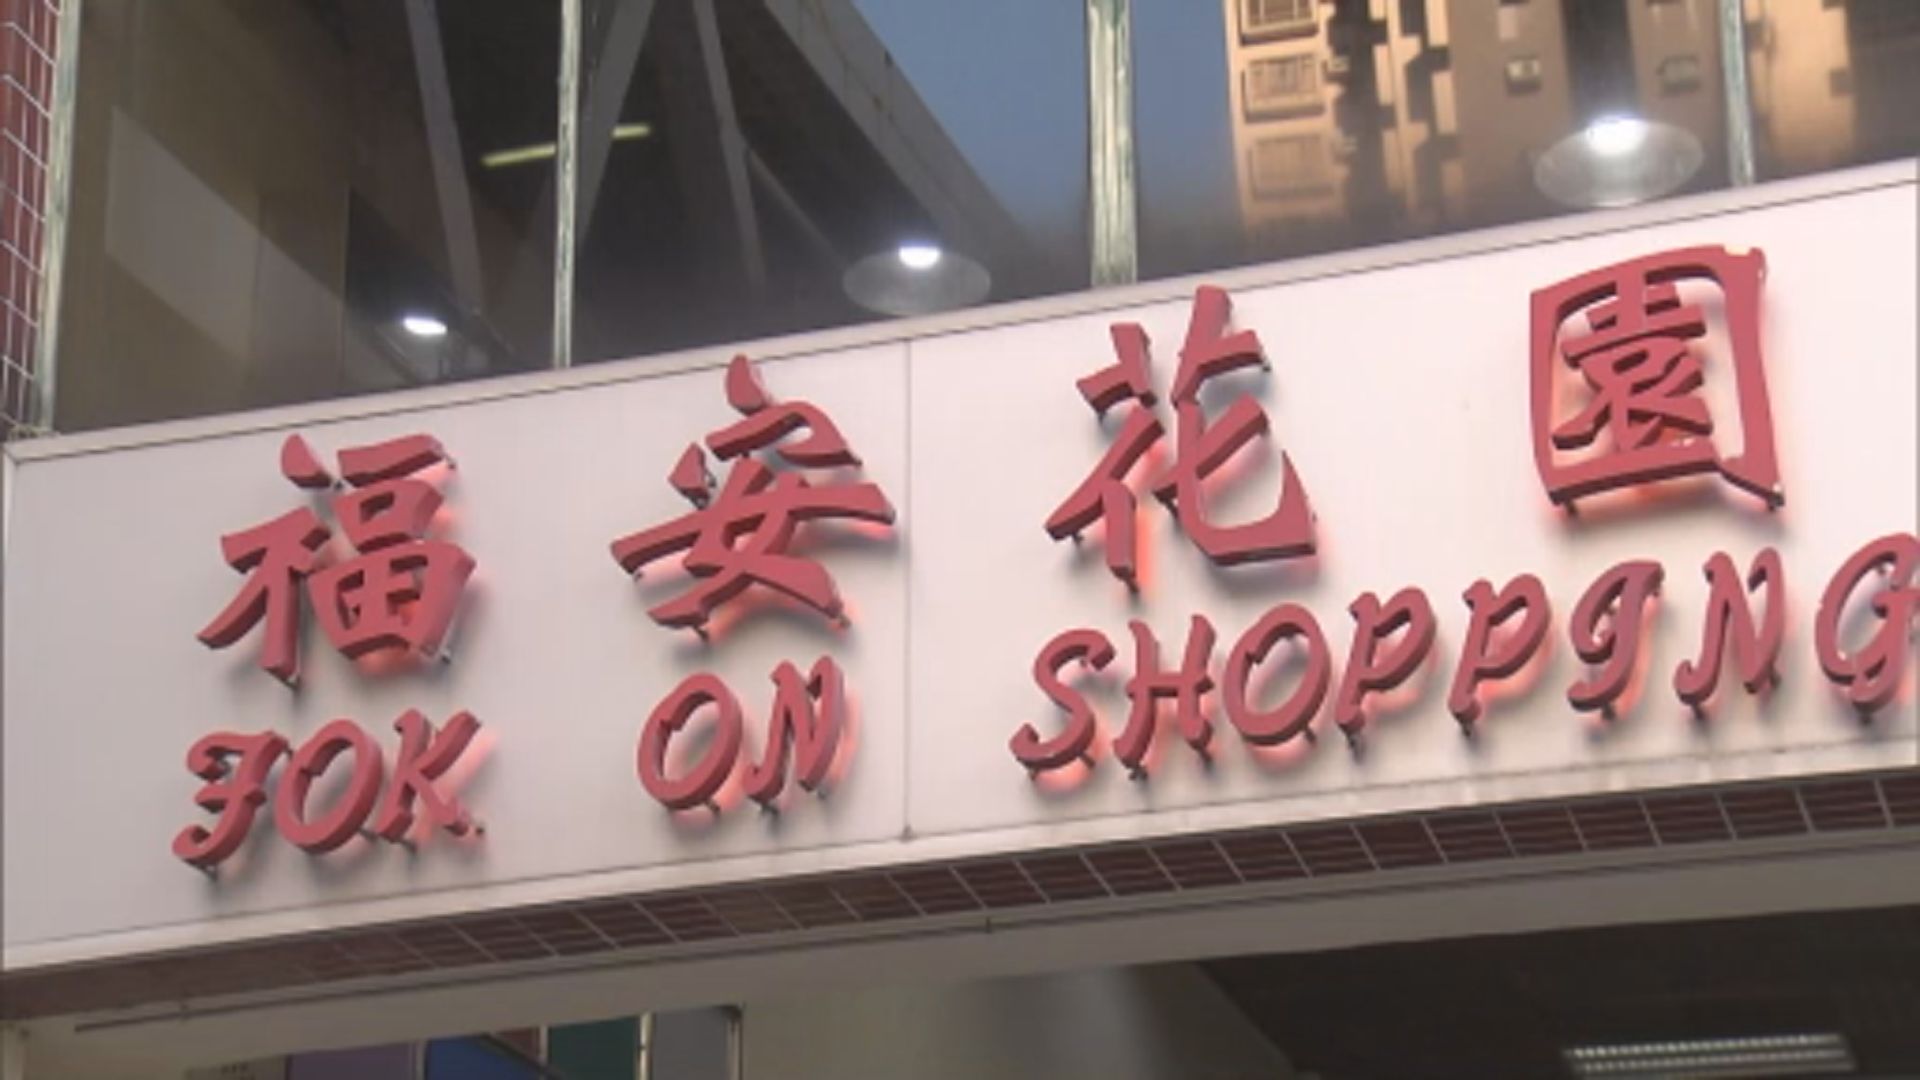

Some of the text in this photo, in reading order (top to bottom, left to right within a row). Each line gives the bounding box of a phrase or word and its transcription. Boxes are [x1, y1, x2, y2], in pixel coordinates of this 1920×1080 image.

[197, 245, 1785, 675] 福安花園
[172, 533, 1917, 864] FOK ON SHOPPING
